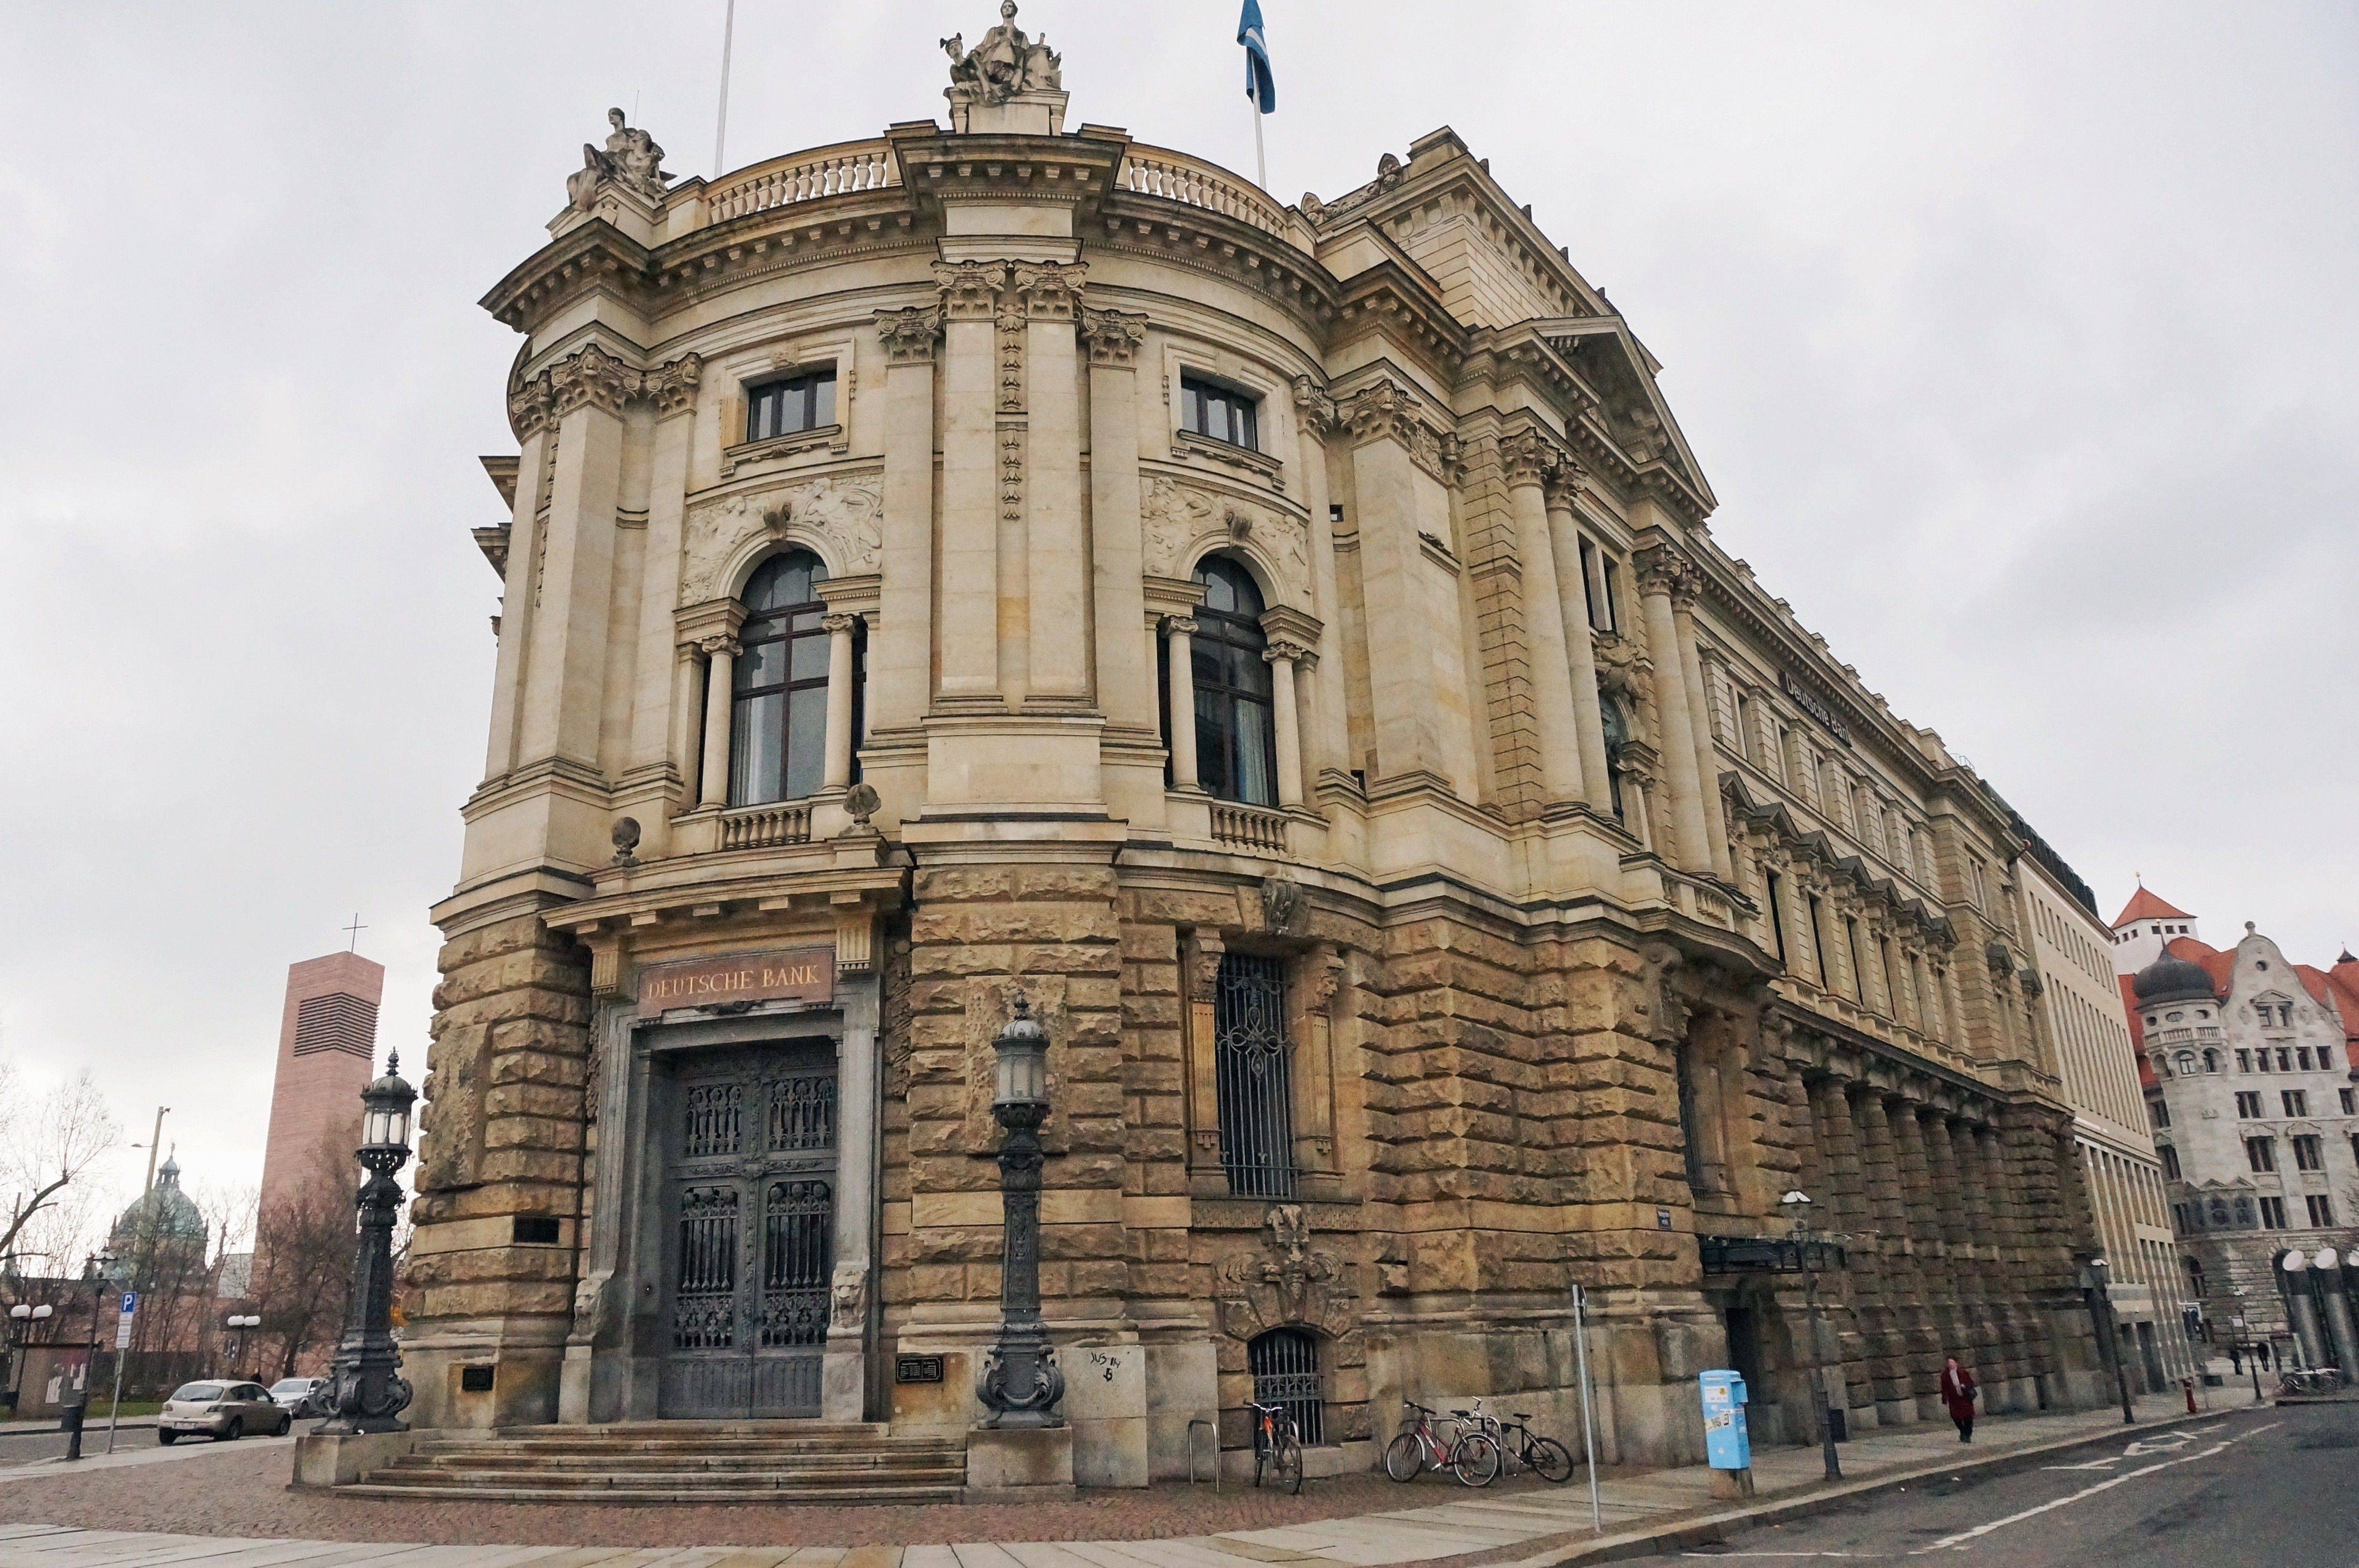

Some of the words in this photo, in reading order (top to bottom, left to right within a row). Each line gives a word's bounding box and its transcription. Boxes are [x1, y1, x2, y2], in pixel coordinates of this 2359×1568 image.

[1785, 670, 1830, 726] Deutsche
[648, 970, 754, 998] DEUTSCHE
[763, 965, 821, 988] BANK
[123, 1295, 133, 1311] P
